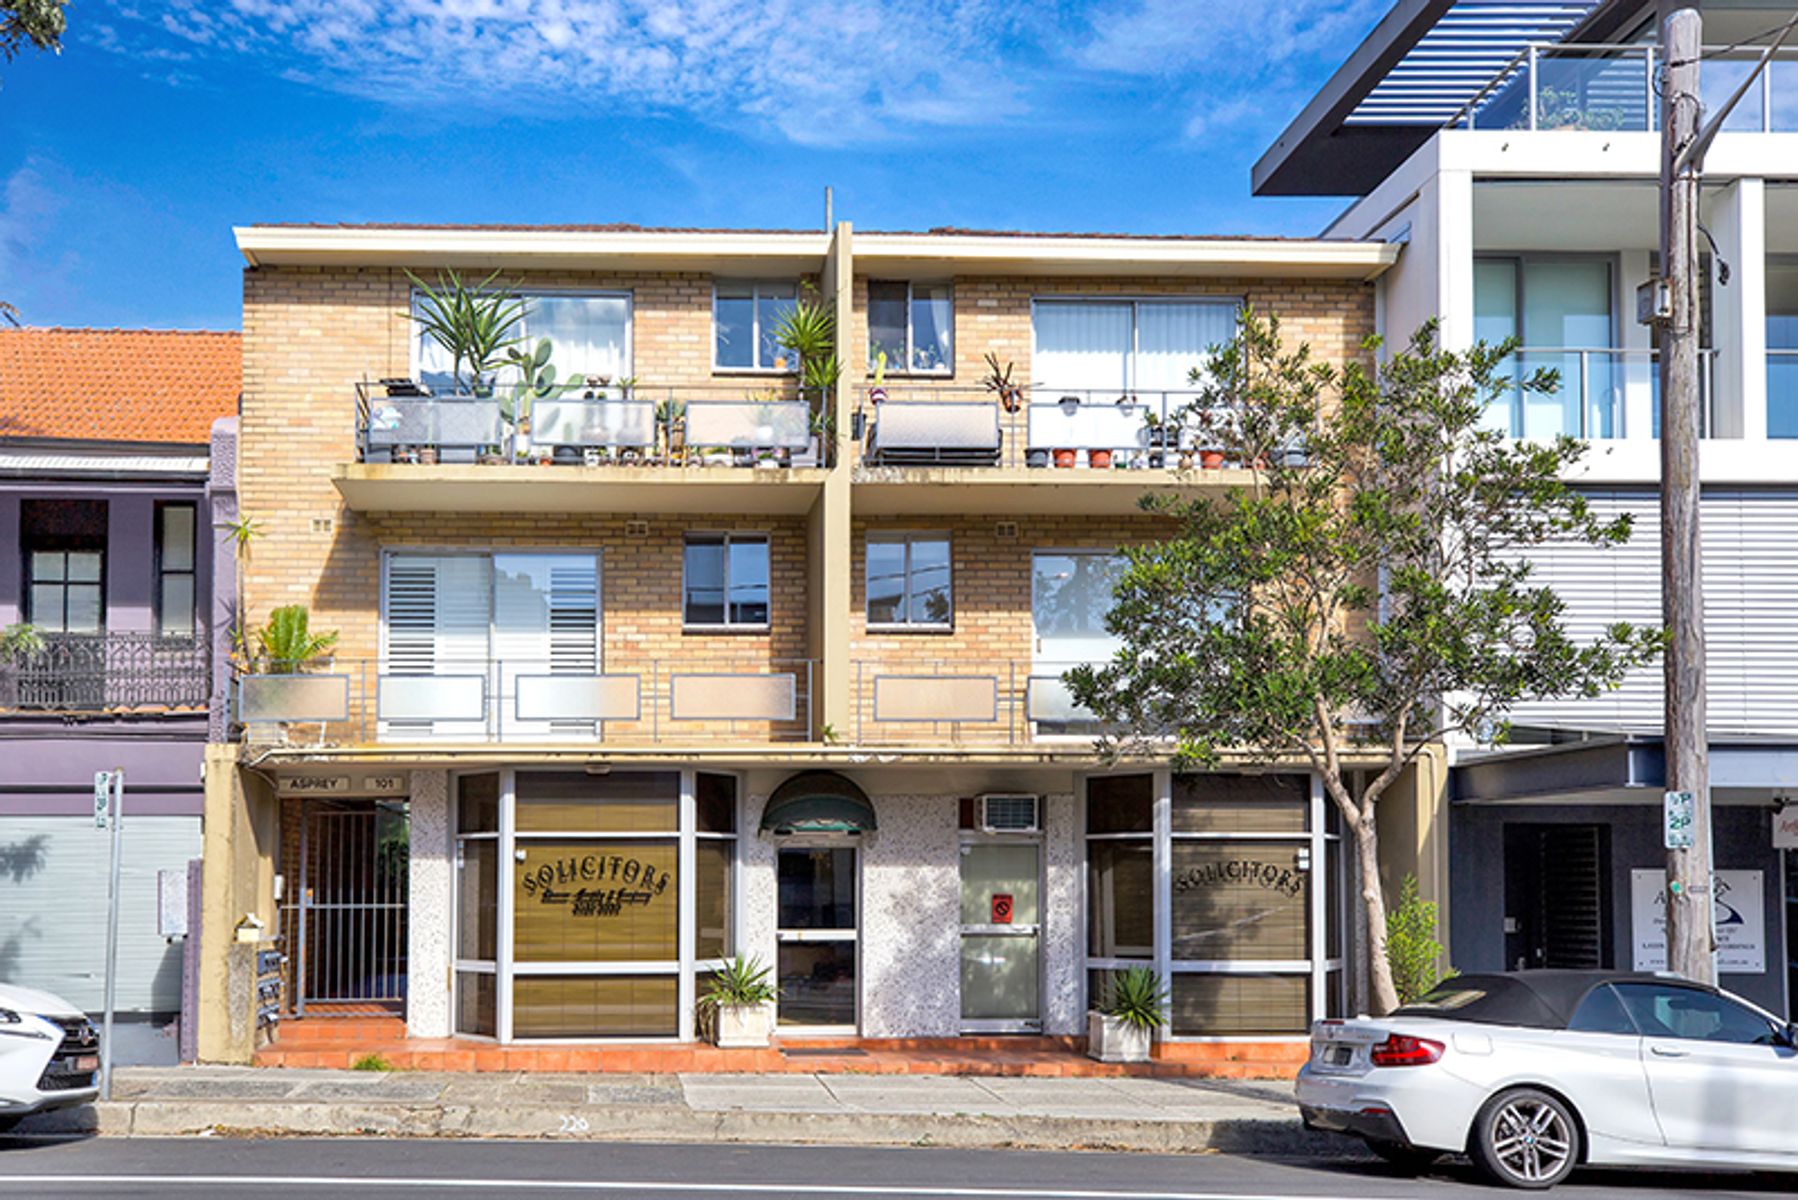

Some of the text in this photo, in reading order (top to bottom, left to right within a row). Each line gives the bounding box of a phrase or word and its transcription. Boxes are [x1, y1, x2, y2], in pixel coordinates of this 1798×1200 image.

[290, 778, 338, 789] ASPREY
[522, 855, 671, 897] SOLICITORS
[1176, 860, 1304, 896] SOLICITORS
